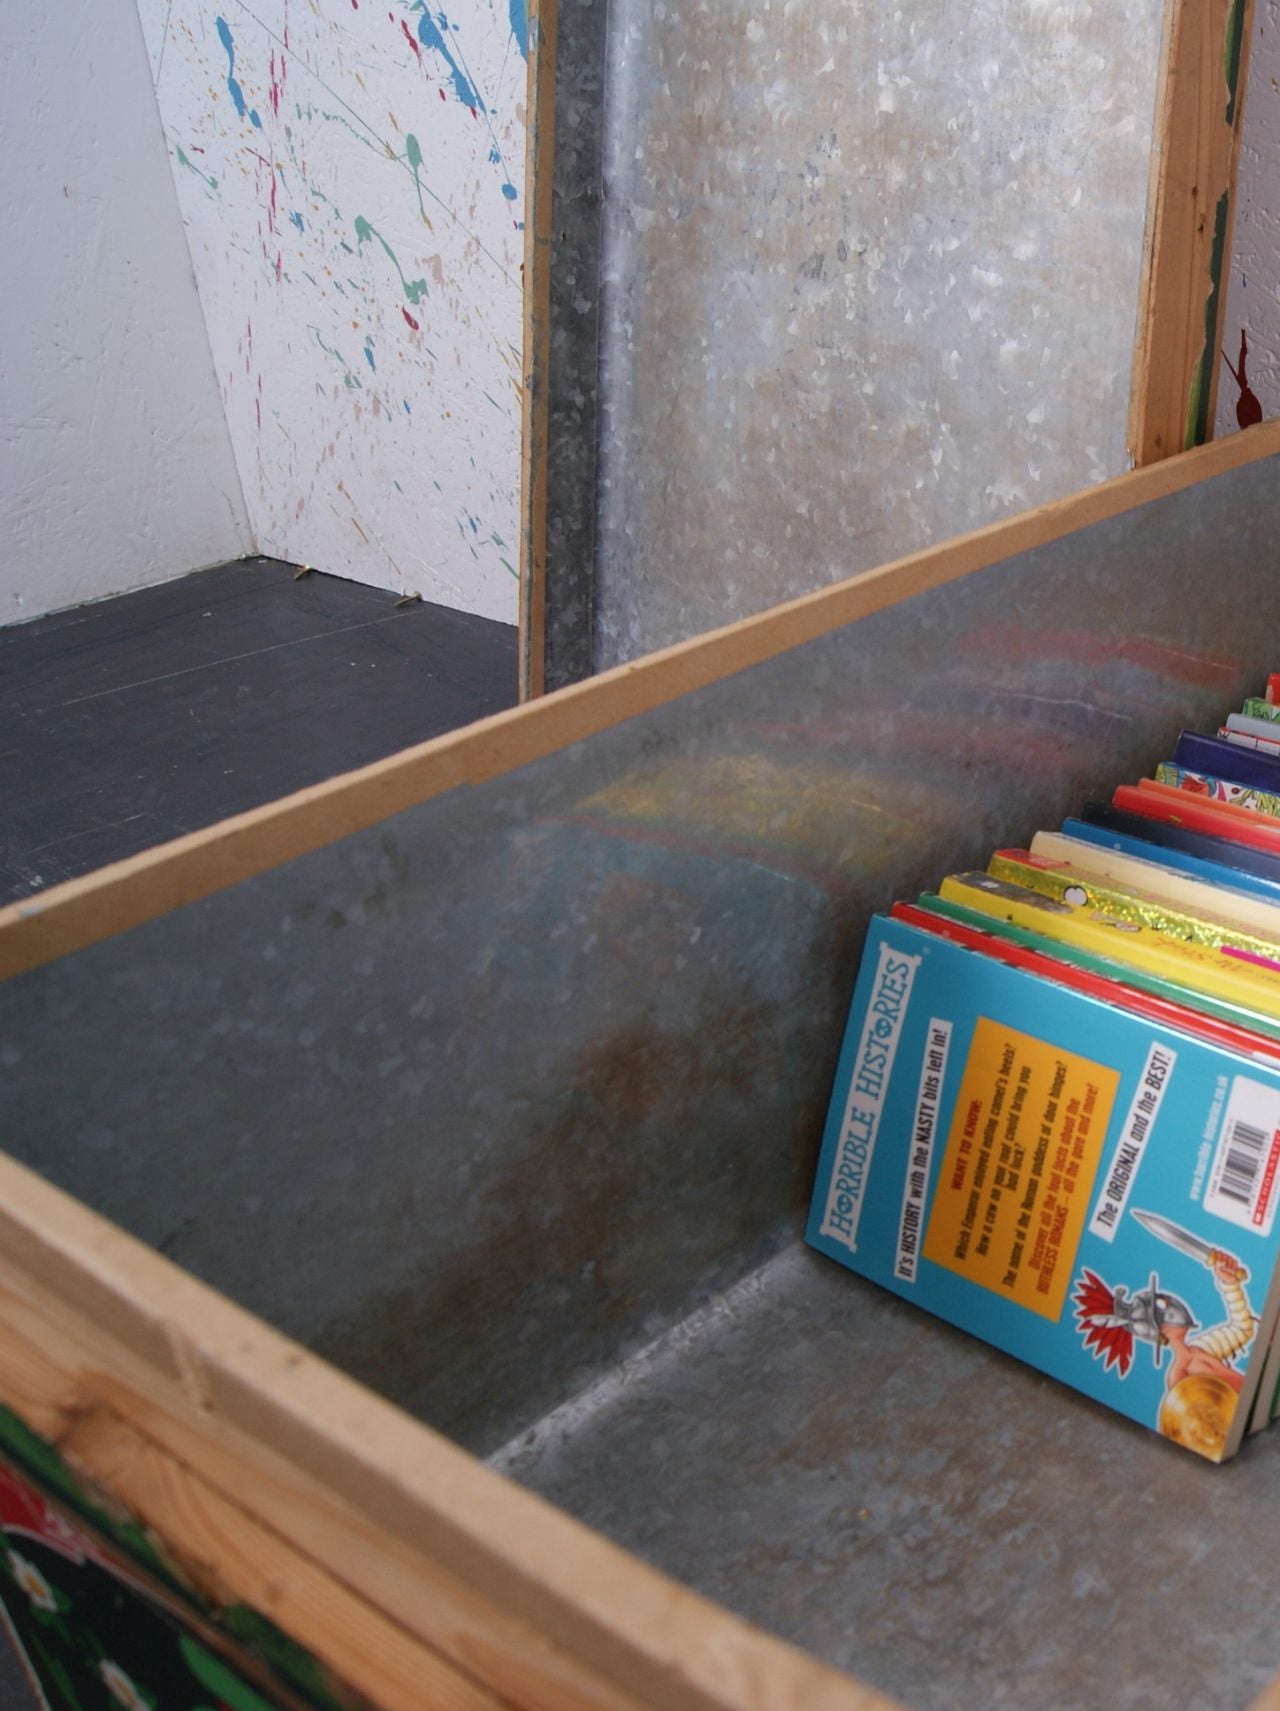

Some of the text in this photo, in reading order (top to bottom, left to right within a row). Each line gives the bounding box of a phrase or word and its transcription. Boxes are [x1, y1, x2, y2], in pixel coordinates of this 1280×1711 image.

[828, 959, 908, 1236] HORRIBLE HISTORIES
[897, 1028, 947, 1277] It's HISTORY with the NASTY bits left in!
[951, 1100, 981, 1190] WANT TO KNOW:
[1096, 1050, 1168, 1227] The ORIGINAL and the BEST!
